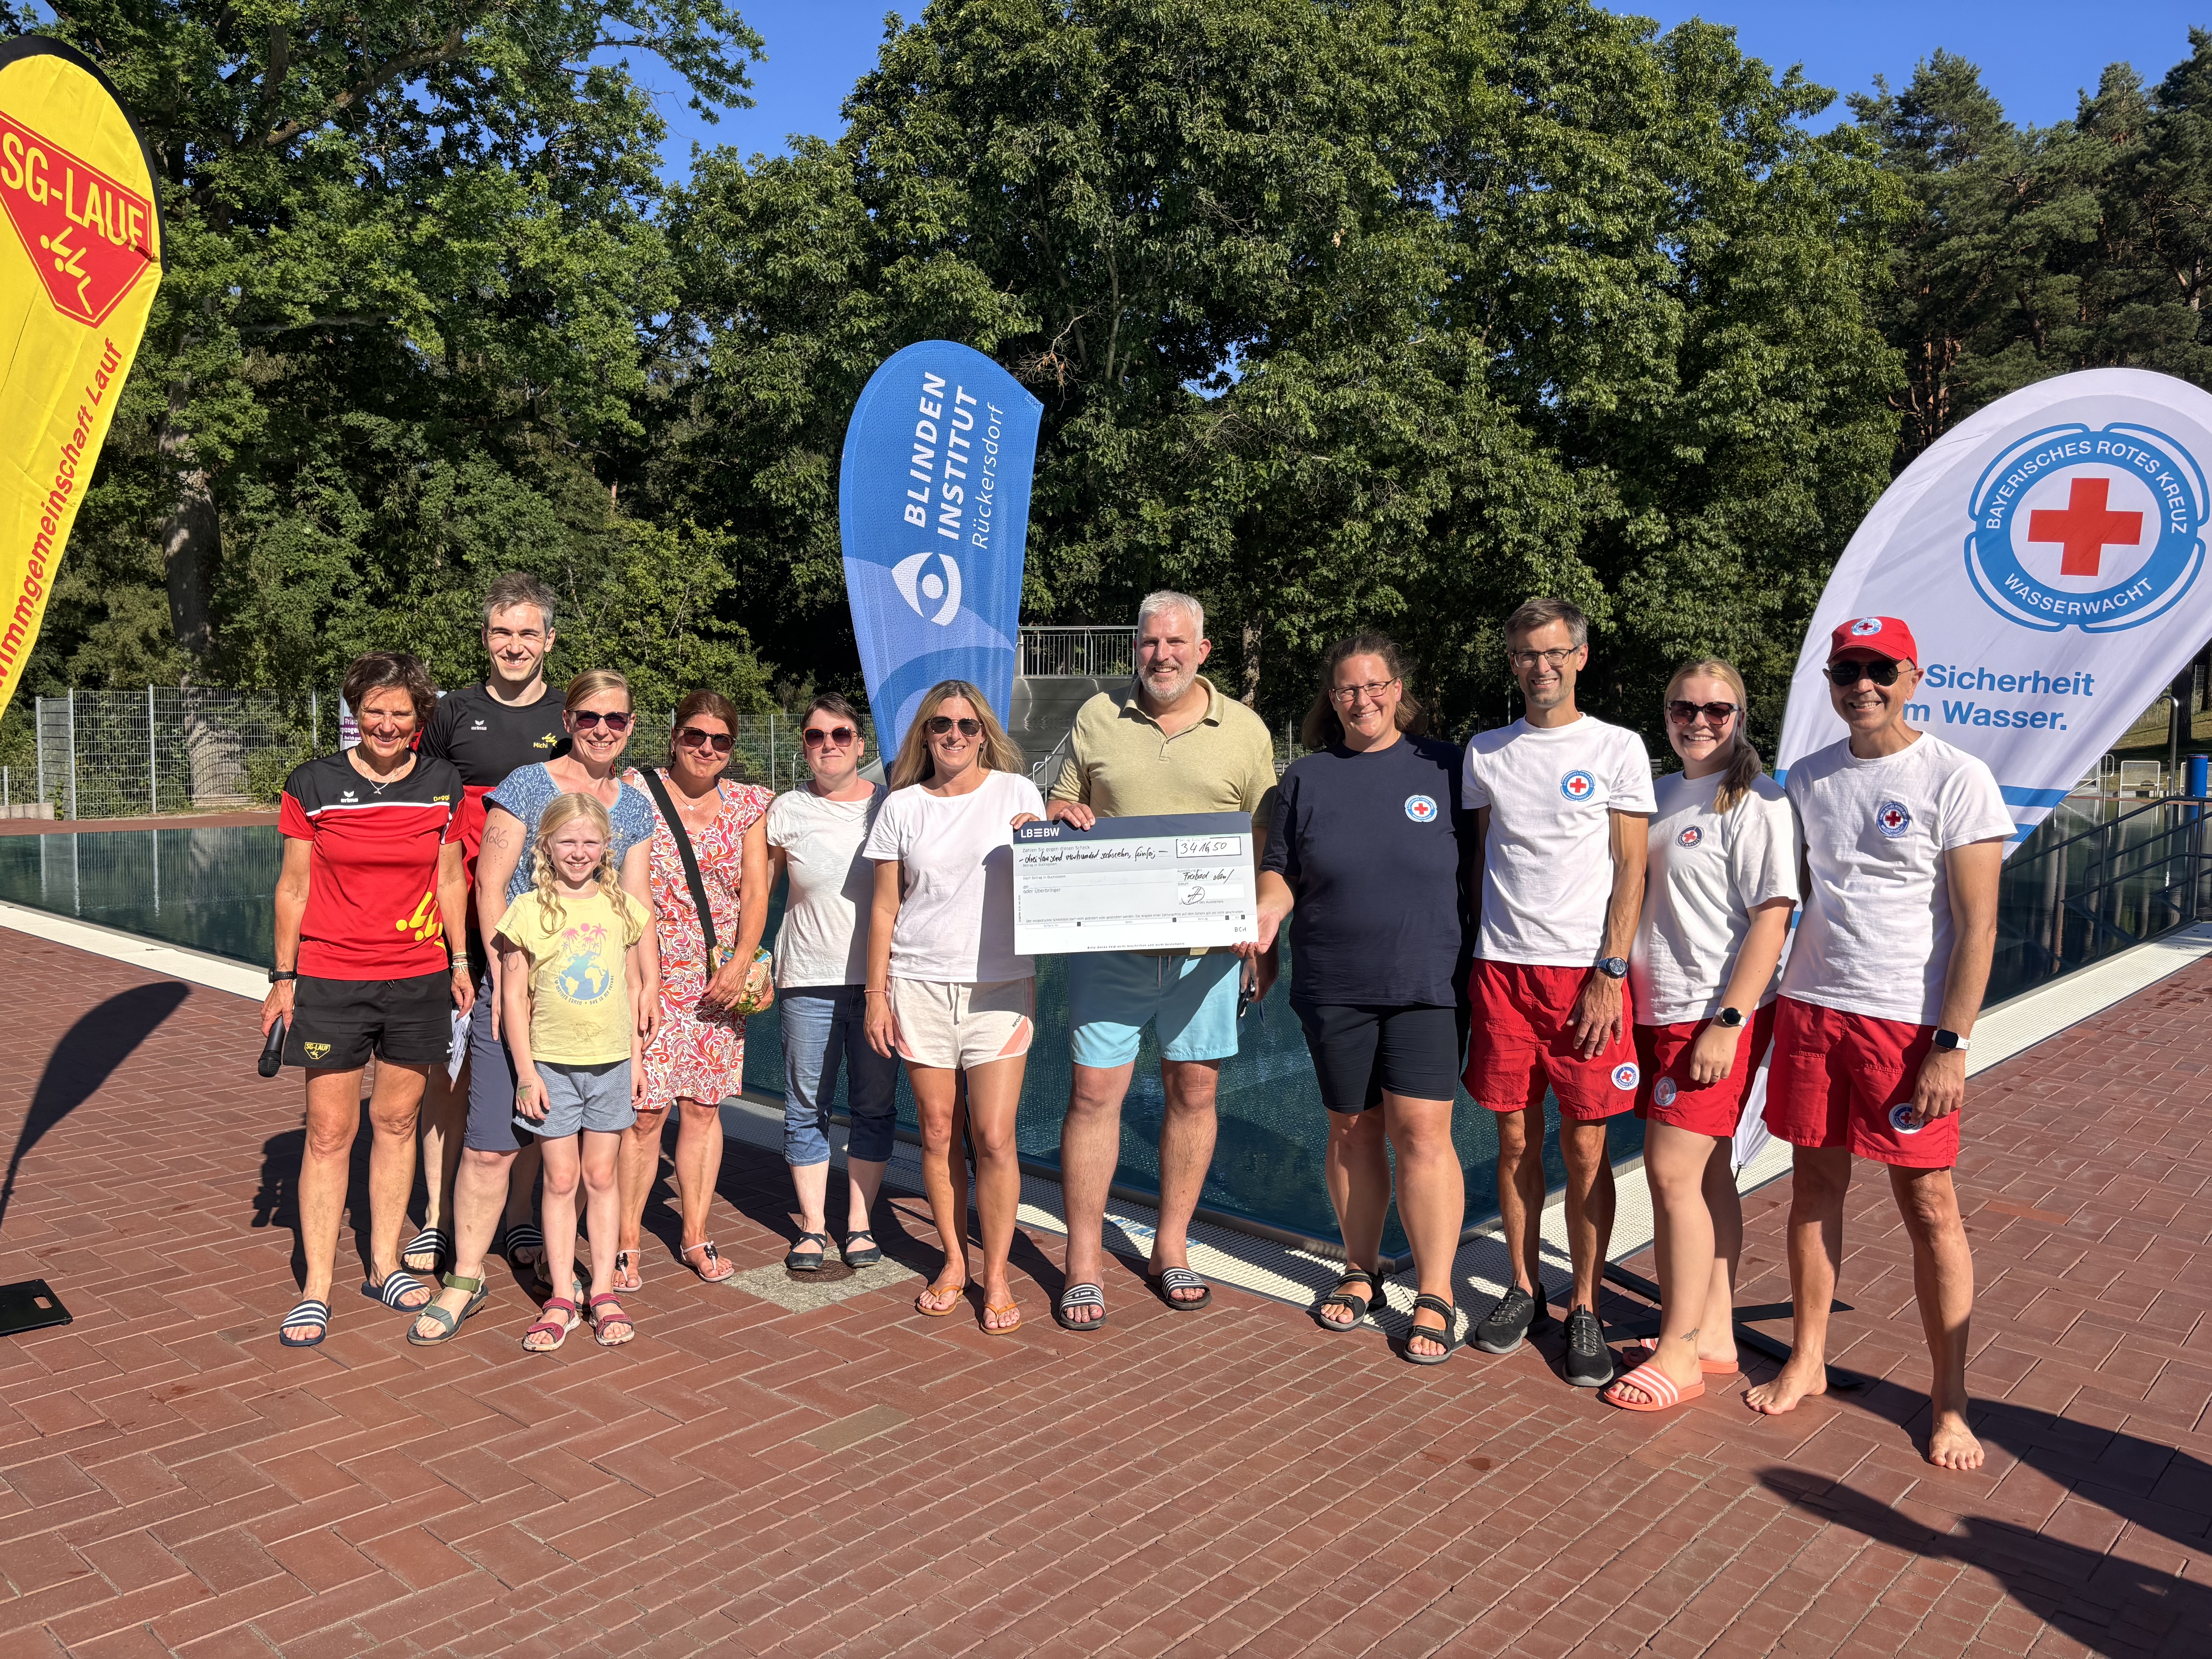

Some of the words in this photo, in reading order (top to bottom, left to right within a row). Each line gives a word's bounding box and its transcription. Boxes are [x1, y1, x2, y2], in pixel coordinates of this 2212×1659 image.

[2, 131, 145, 252] SG-LAUF
[86, 337, 122, 407] Lauf
[904, 371, 947, 528] BLINDEN
[938, 385, 977, 541] INSTITUT
[972, 402, 1005, 549] Rückersdorf
[1986, 440, 2091, 529] BAYERISCHES
[2096, 441, 2160, 475] ROTES
[2155, 471, 2188, 534] KREUZ
[2003, 573, 2154, 616] WASSERWACHT
[1925, 663, 2095, 697] Sicherheit
[1903, 703, 1930, 722] m
[1942, 700, 2068, 731] Wasser.
[483, 824, 509, 849] 126
[1183, 869, 1210, 881] Freibad
[306, 1043, 330, 1051] SG-LAUF
